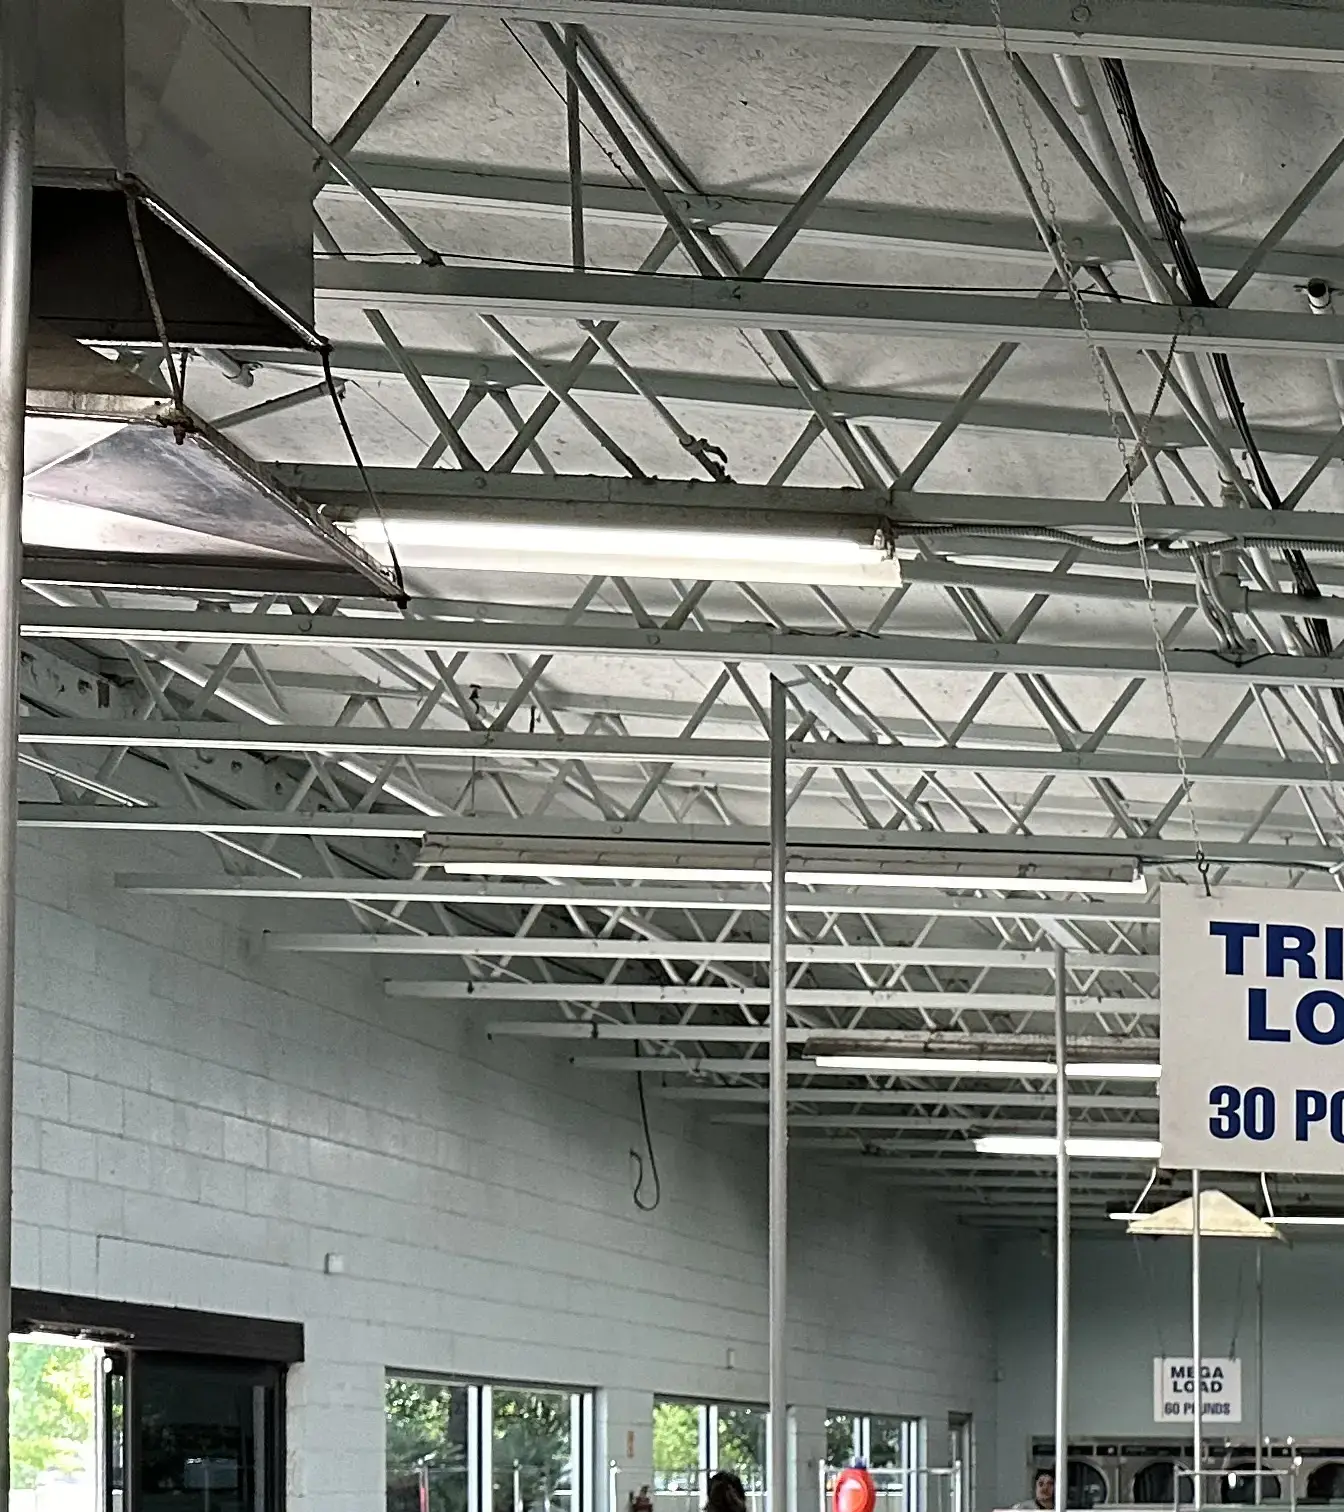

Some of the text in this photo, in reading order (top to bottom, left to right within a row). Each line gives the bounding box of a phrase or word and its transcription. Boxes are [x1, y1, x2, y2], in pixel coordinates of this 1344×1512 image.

[1208, 1085, 1276, 1141] 30
[1171, 1366, 1224, 1379] MEGA
[1173, 1380, 1223, 1393] LOAD
